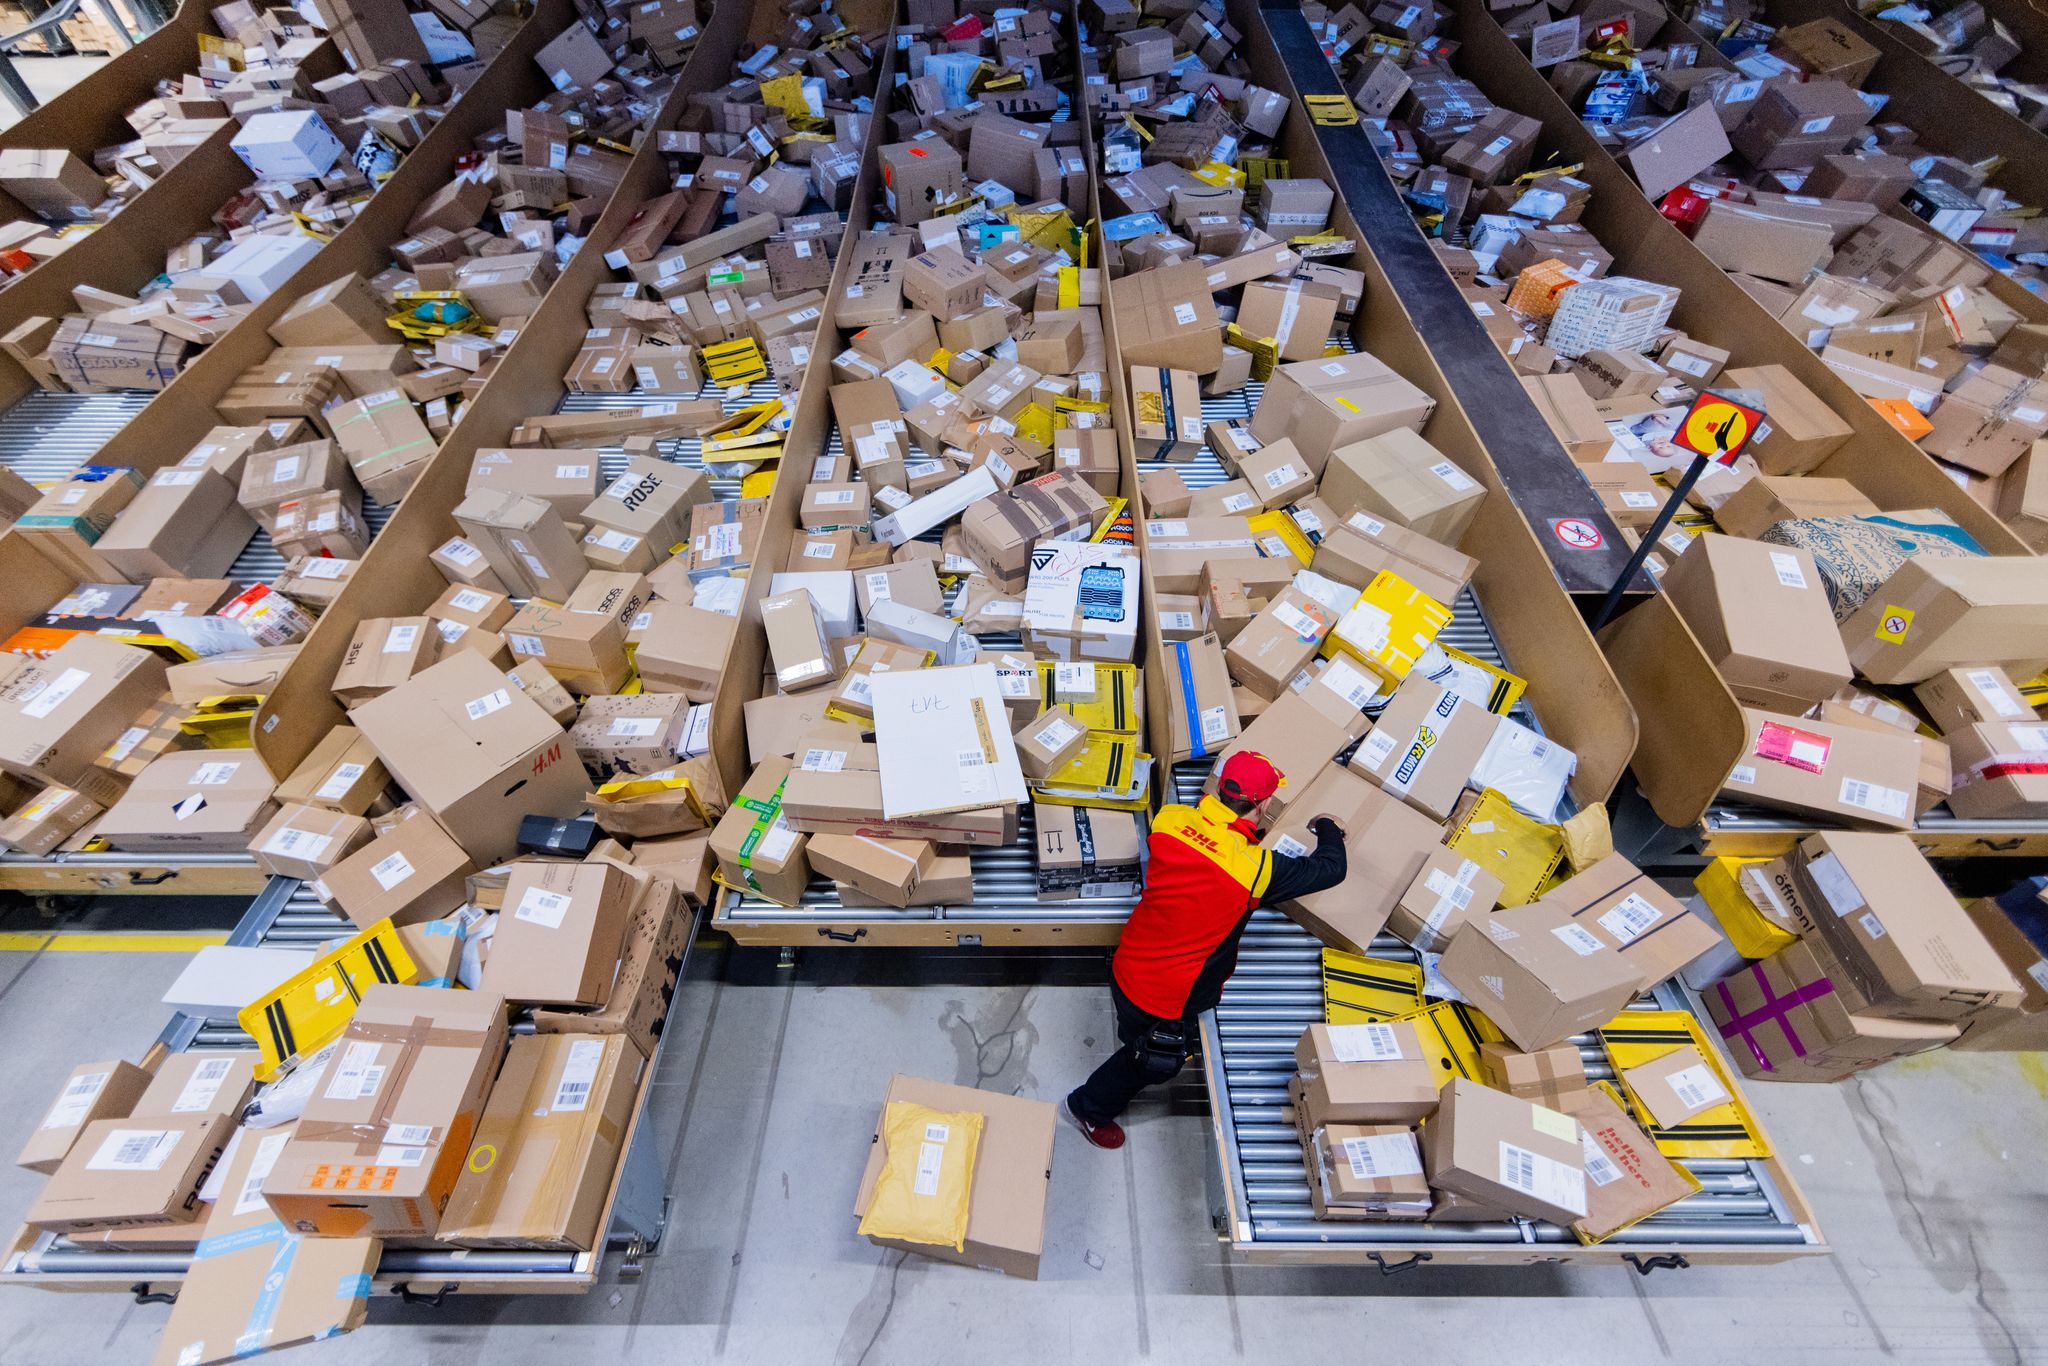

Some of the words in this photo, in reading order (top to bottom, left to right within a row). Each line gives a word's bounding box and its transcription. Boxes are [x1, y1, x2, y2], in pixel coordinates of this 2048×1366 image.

[622, 472, 662, 511] ROSE
[597, 588, 619, 613] asos
[620, 595, 640, 623] asos
[346, 642, 363, 665] HSE
[532, 743, 562, 776] H&M
[1395, 754, 1417, 784] MOTO
[1180, 825, 1219, 854] DHL
[1597, 1130, 1618, 1154] i'm
[1618, 1154, 1650, 1188] here
[1605, 1127, 1641, 1167] hello.
